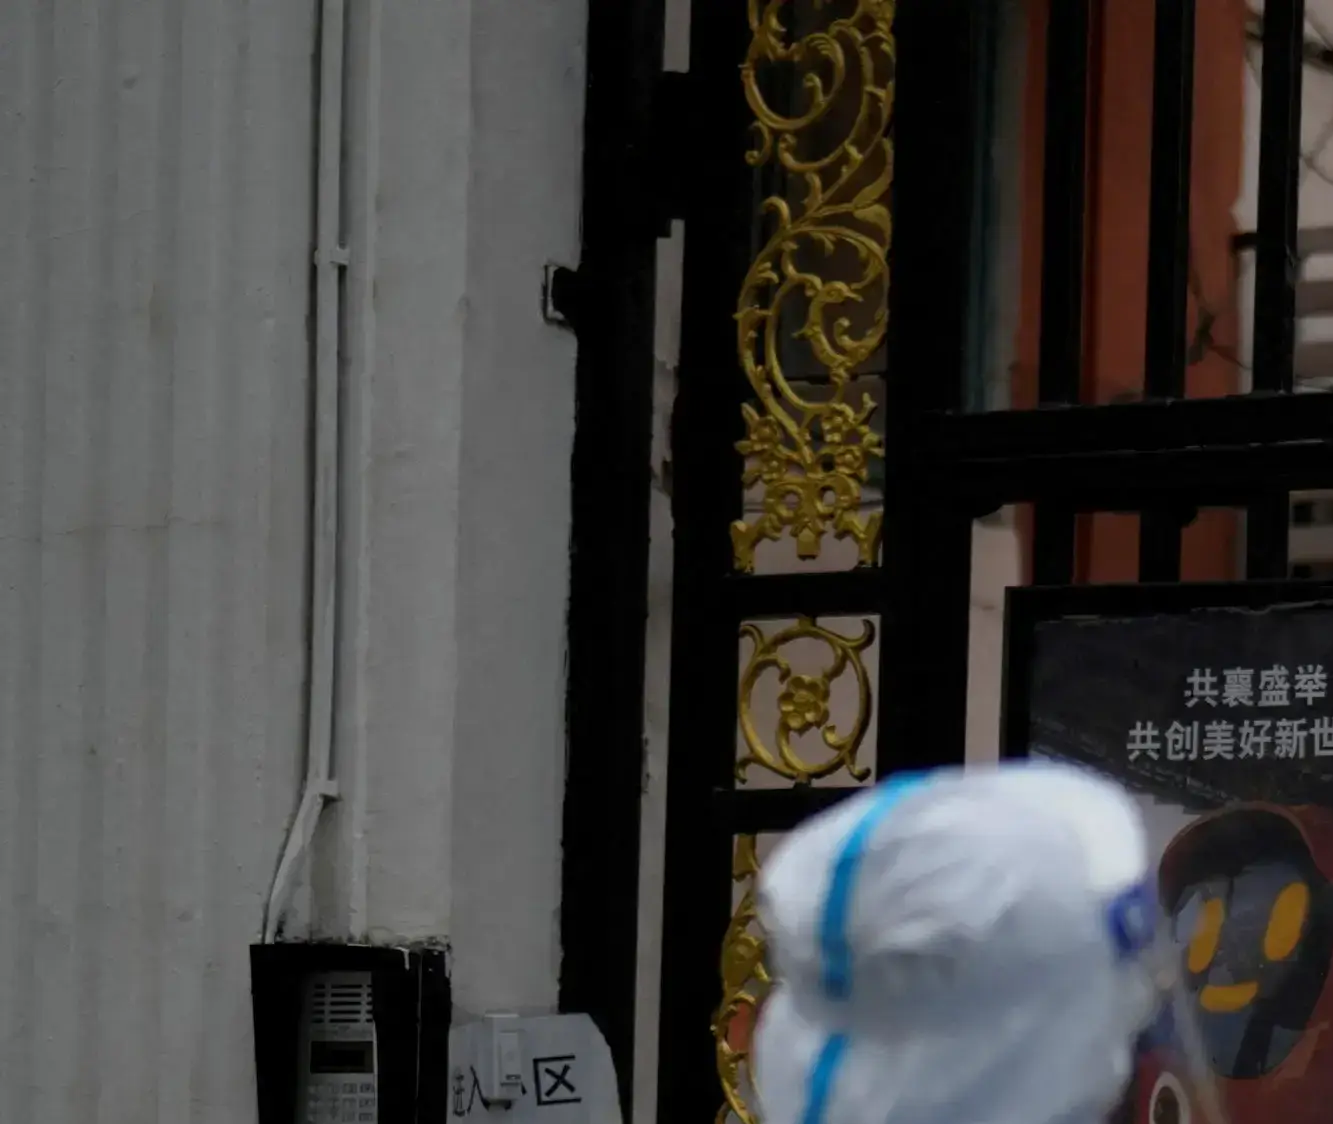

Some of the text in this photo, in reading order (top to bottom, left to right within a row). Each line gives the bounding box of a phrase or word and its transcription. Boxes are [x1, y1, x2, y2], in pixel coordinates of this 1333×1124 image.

[1184, 664, 1328, 707] 共襄盛举
[453, 1055, 582, 1117] 进入区
